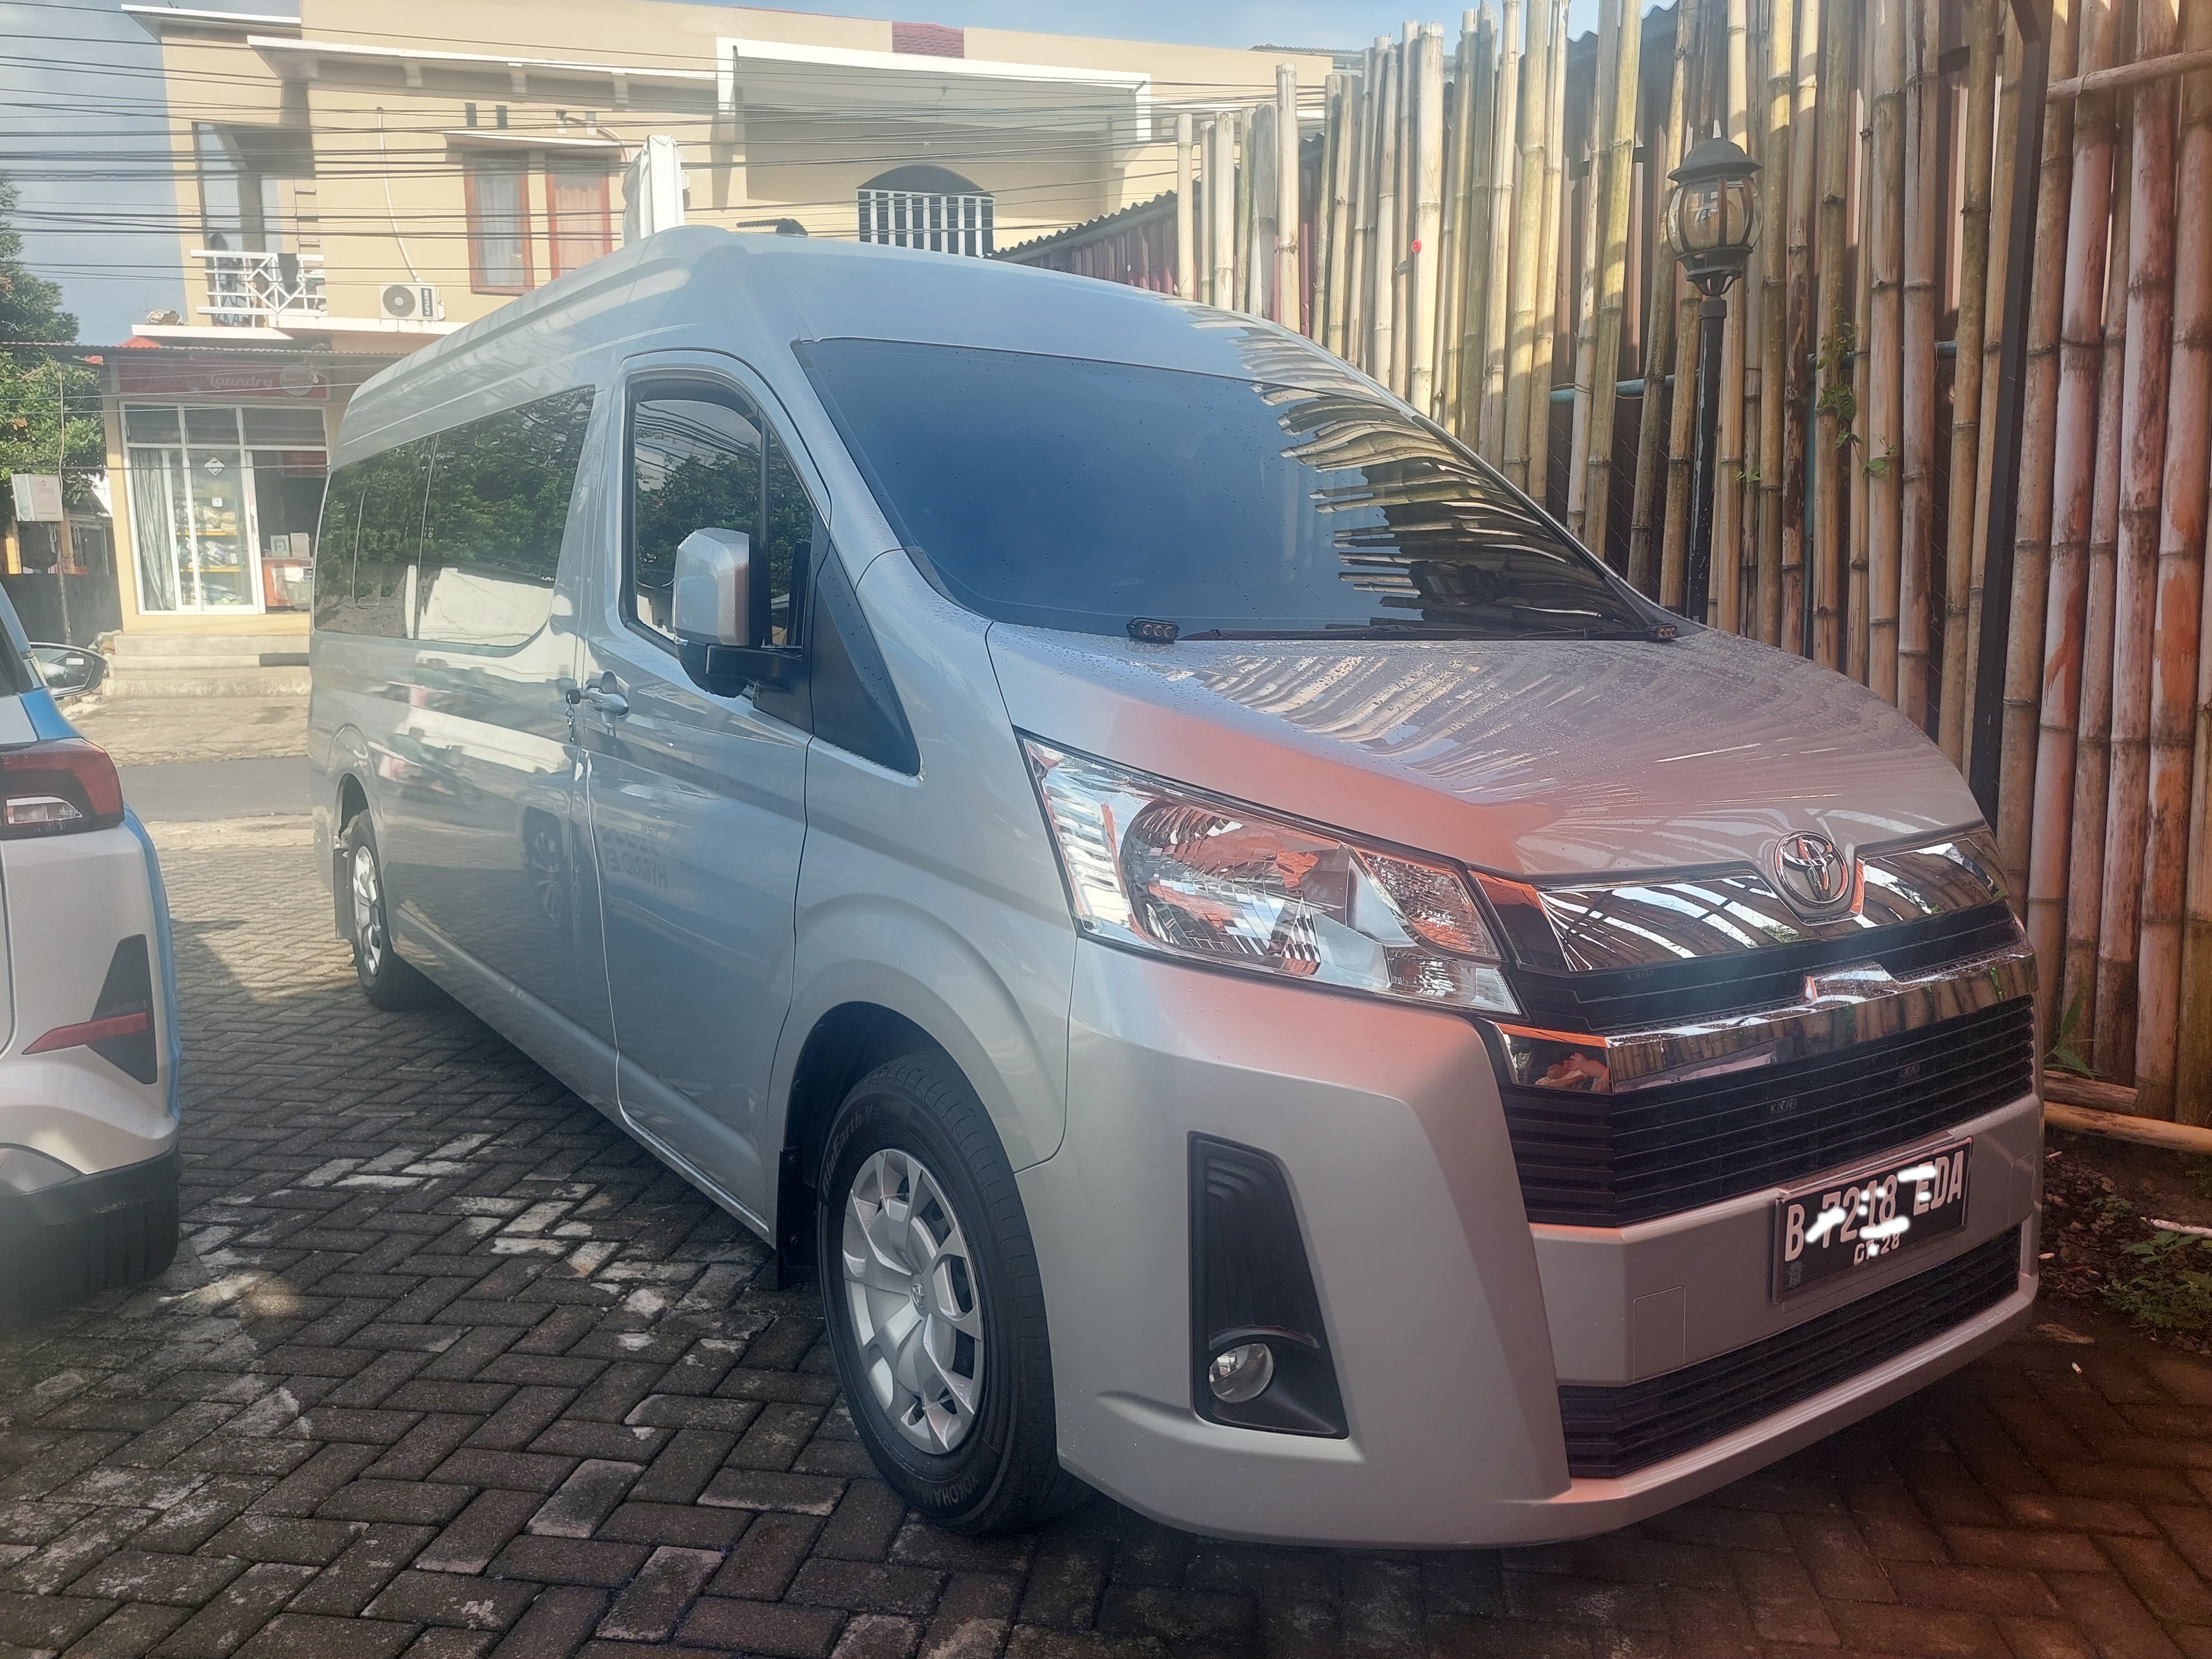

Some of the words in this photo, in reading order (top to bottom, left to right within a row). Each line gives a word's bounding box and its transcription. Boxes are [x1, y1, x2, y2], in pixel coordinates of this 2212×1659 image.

[207, 373, 273, 389] Laundry
[1785, 1204, 1805, 1262] B
[1822, 1174, 1898, 1249] 7218
[1913, 1150, 1964, 1216] EDA
